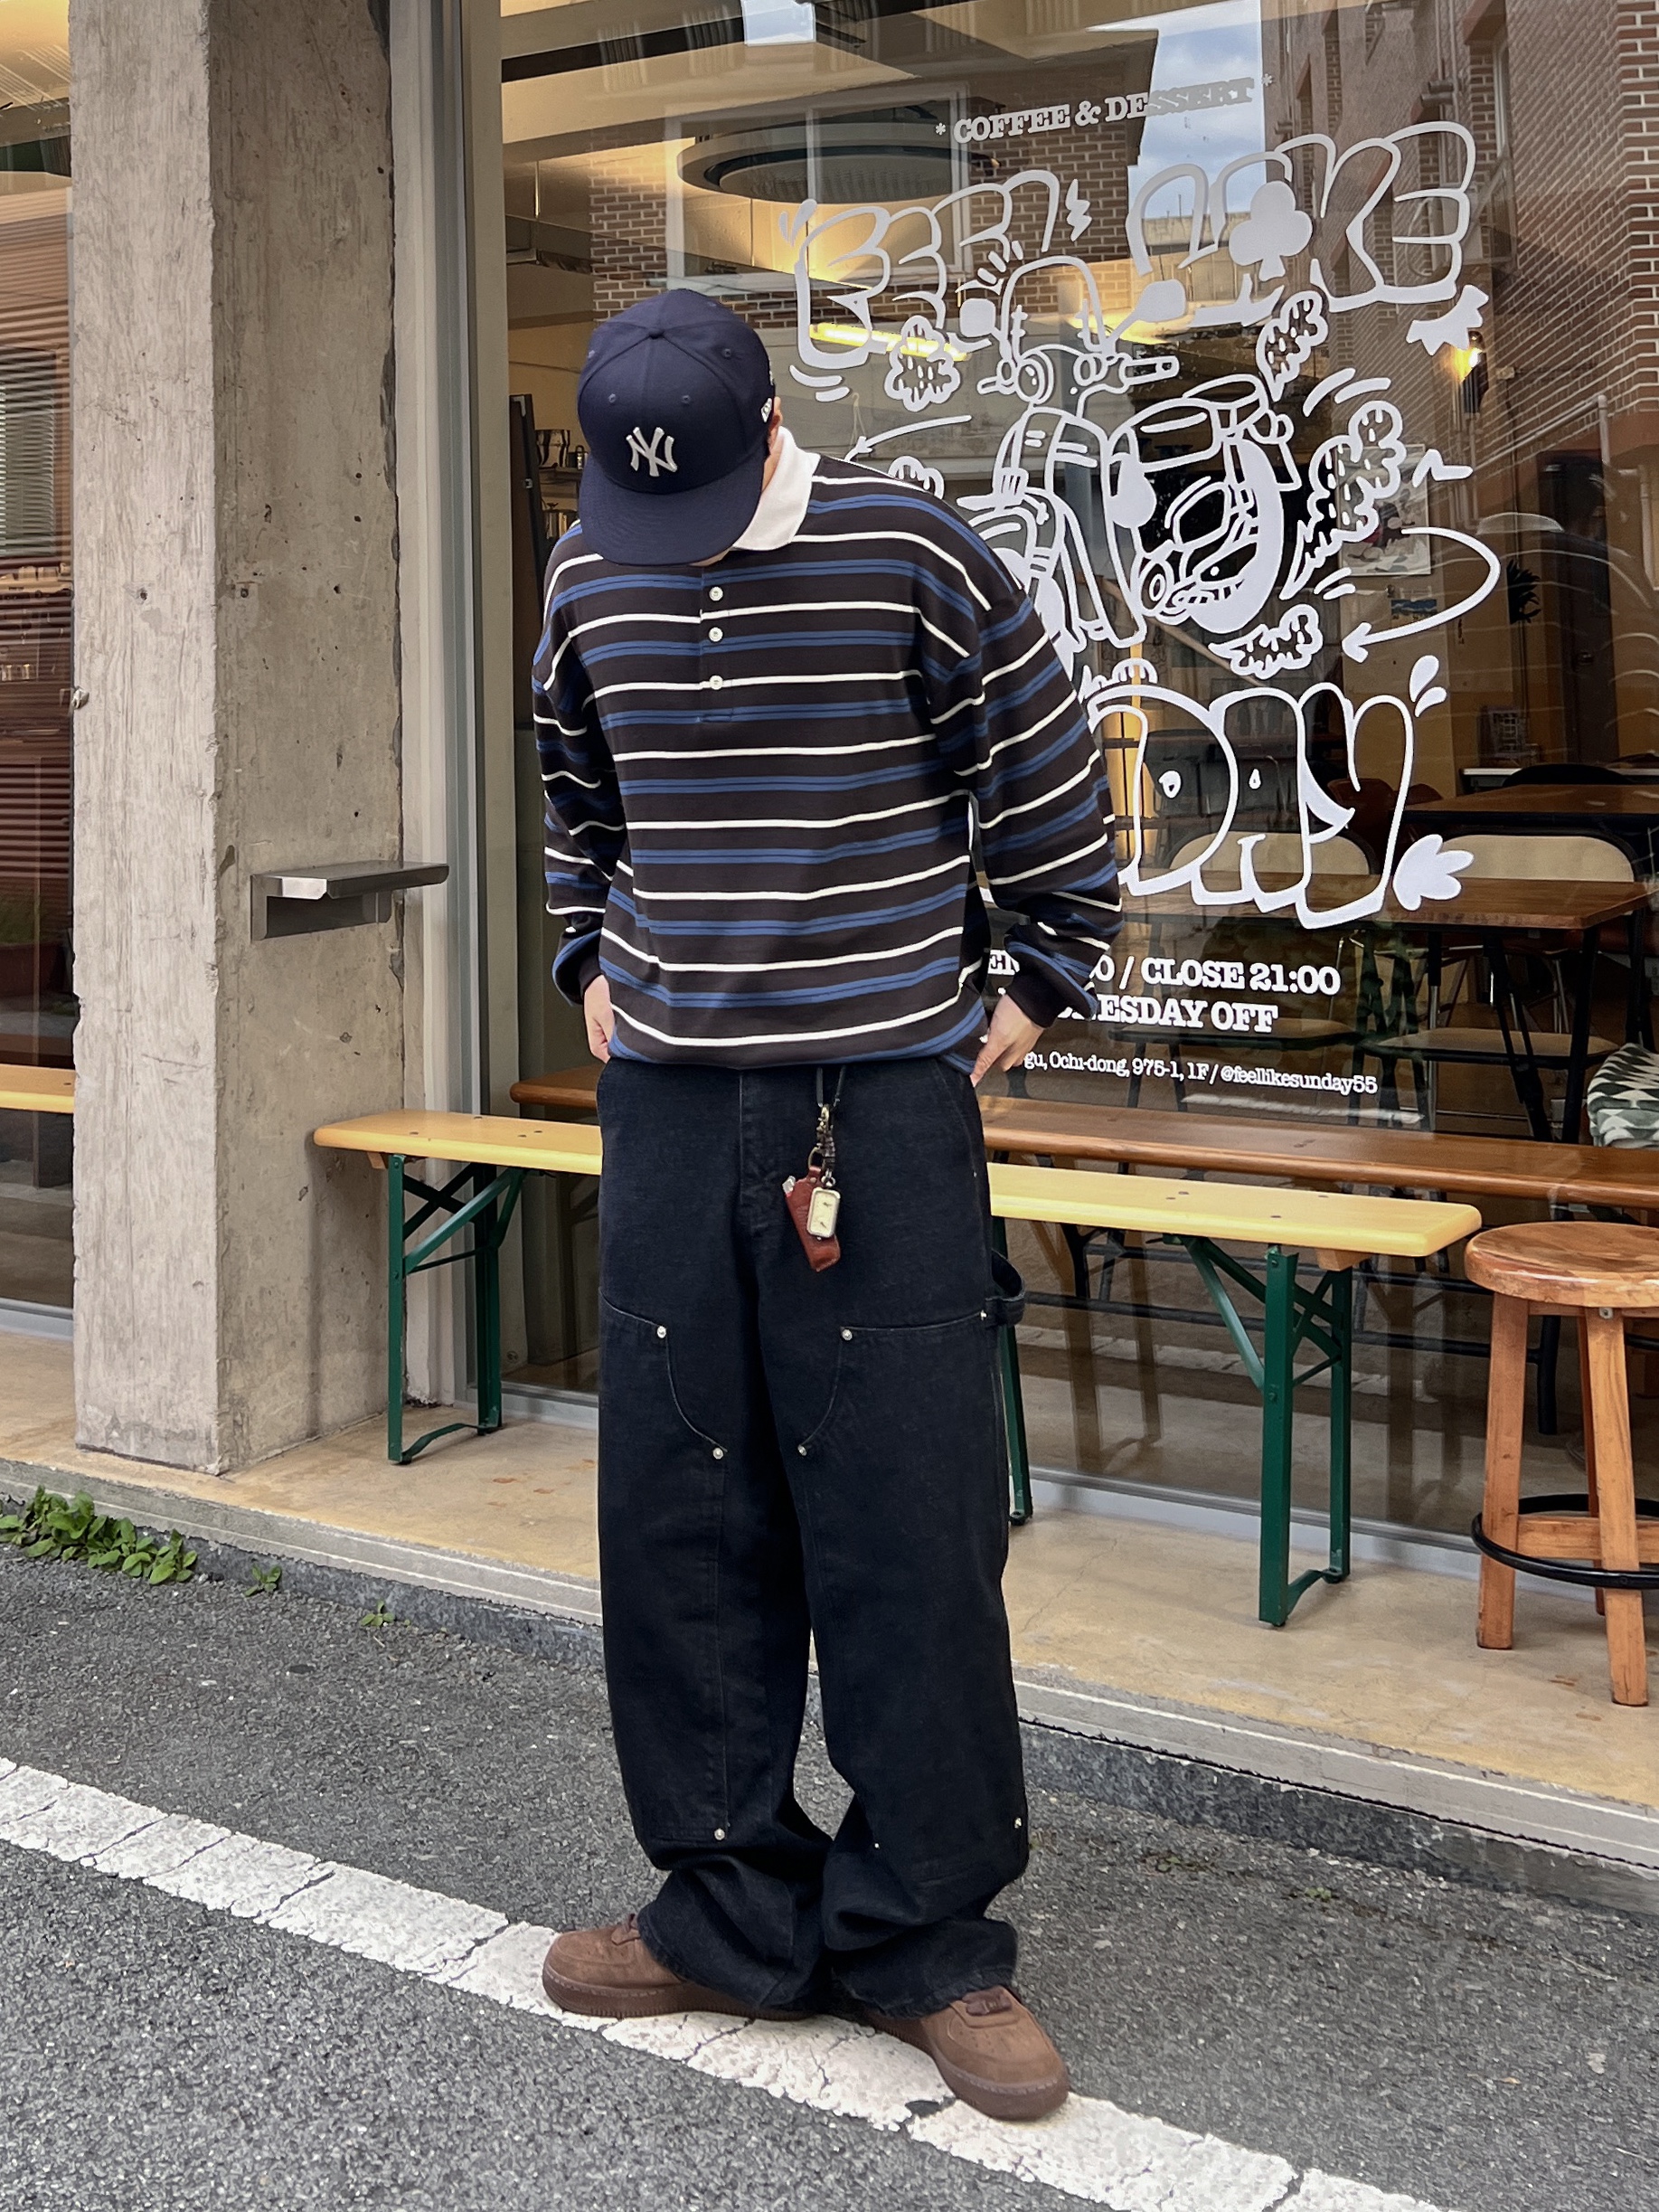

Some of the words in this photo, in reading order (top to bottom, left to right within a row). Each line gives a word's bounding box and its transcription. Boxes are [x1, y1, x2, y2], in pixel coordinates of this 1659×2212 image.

[953, 104, 1071, 145] COFFEE
[1074, 99, 1103, 127] &
[1105, 76, 1255, 123] DESSERT
[626, 426, 678, 477] NY
[1140, 957, 1246, 990] CLOSE
[1249, 962, 1342, 996] 21:00
[1210, 1000, 1278, 1034] OFF
[1131, 1057, 1184, 1082] 975-1,
[1220, 1064, 1379, 1096] @feellikesunday55
